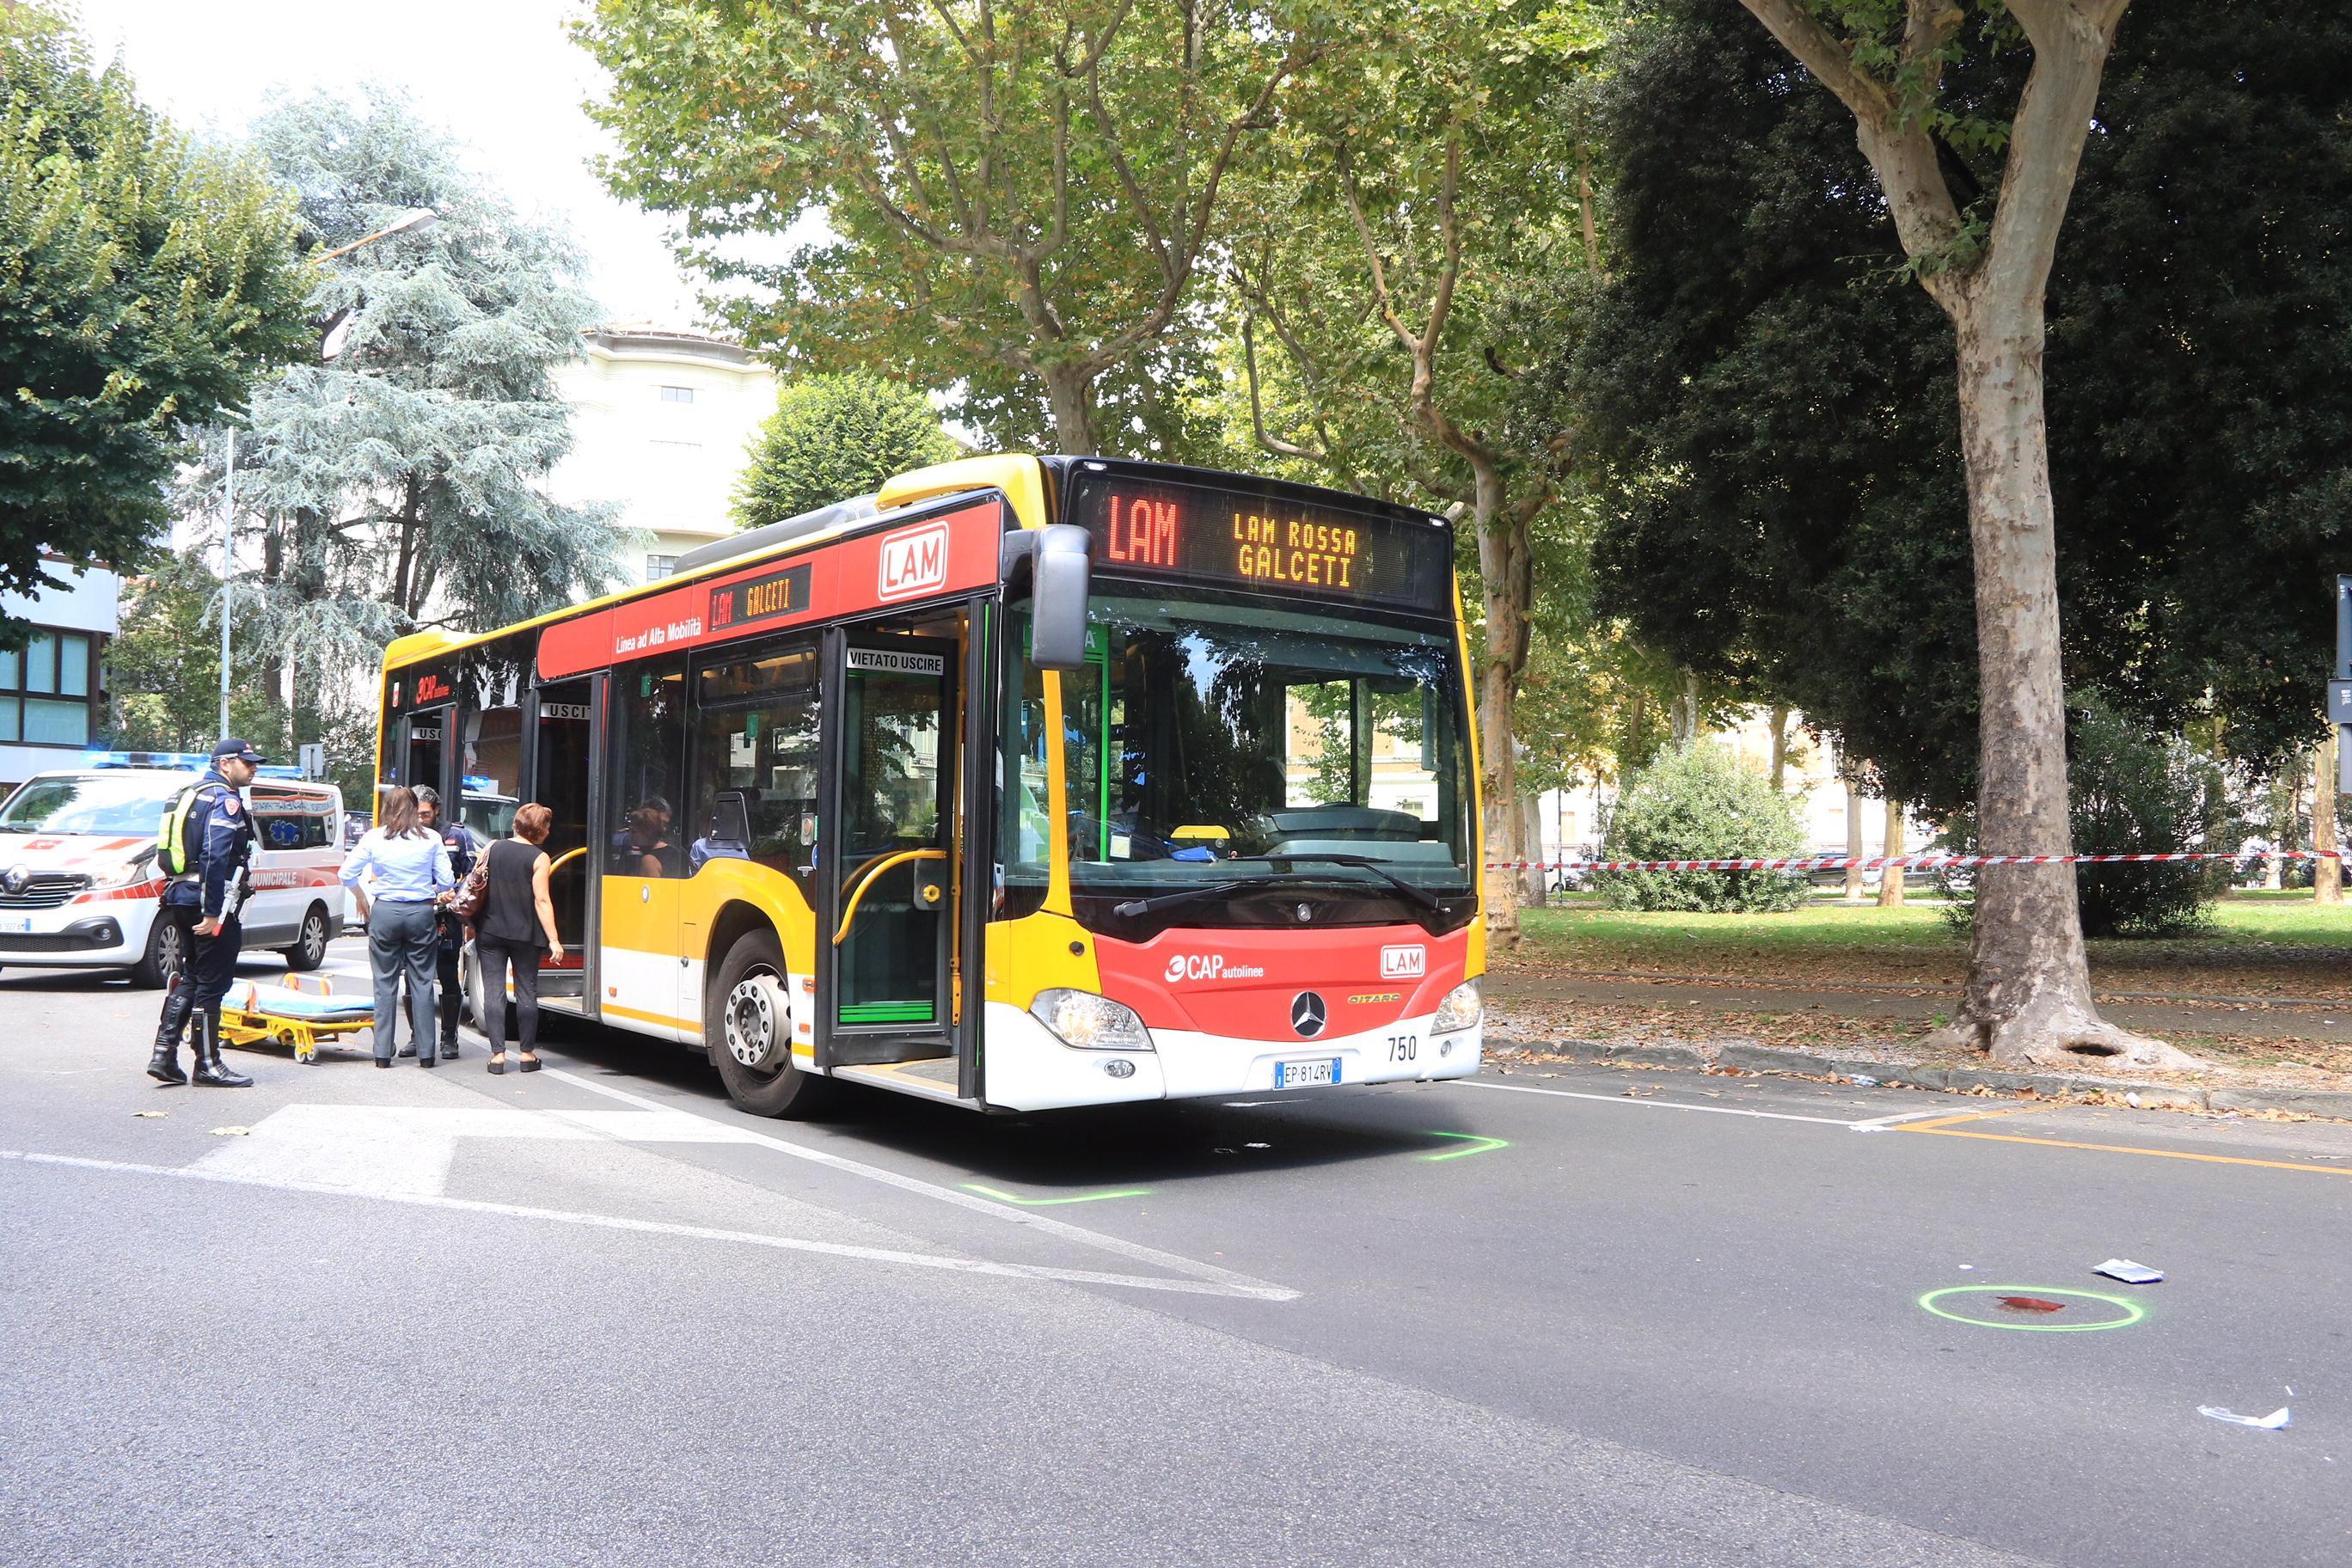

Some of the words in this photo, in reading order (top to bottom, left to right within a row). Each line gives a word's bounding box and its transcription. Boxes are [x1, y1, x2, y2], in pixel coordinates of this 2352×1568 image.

[1109, 495, 1177, 566] LAM
[1234, 513, 1276, 544] LAM
[1289, 522, 1356, 554] ROSSA
[886, 536, 940, 587] LAM
[1239, 544, 1351, 587] GALCETI
[712, 591, 733, 627] LAM
[746, 578, 791, 617] GALCETI
[616, 636, 635, 654] Linea
[637, 632, 647, 648] ad
[649, 627, 665, 644] Alta
[667, 616, 701, 641] Mobilità
[850, 651, 897, 668] VIETATO
[901, 656, 941, 672] USCIRE
[248, 871, 297, 888] MUNICIPALE
[1187, 954, 1223, 980] CAP
[1222, 965, 1264, 979] autolinee
[1387, 951, 1420, 972] LAM
[1387, 1035, 1417, 1062] 750
